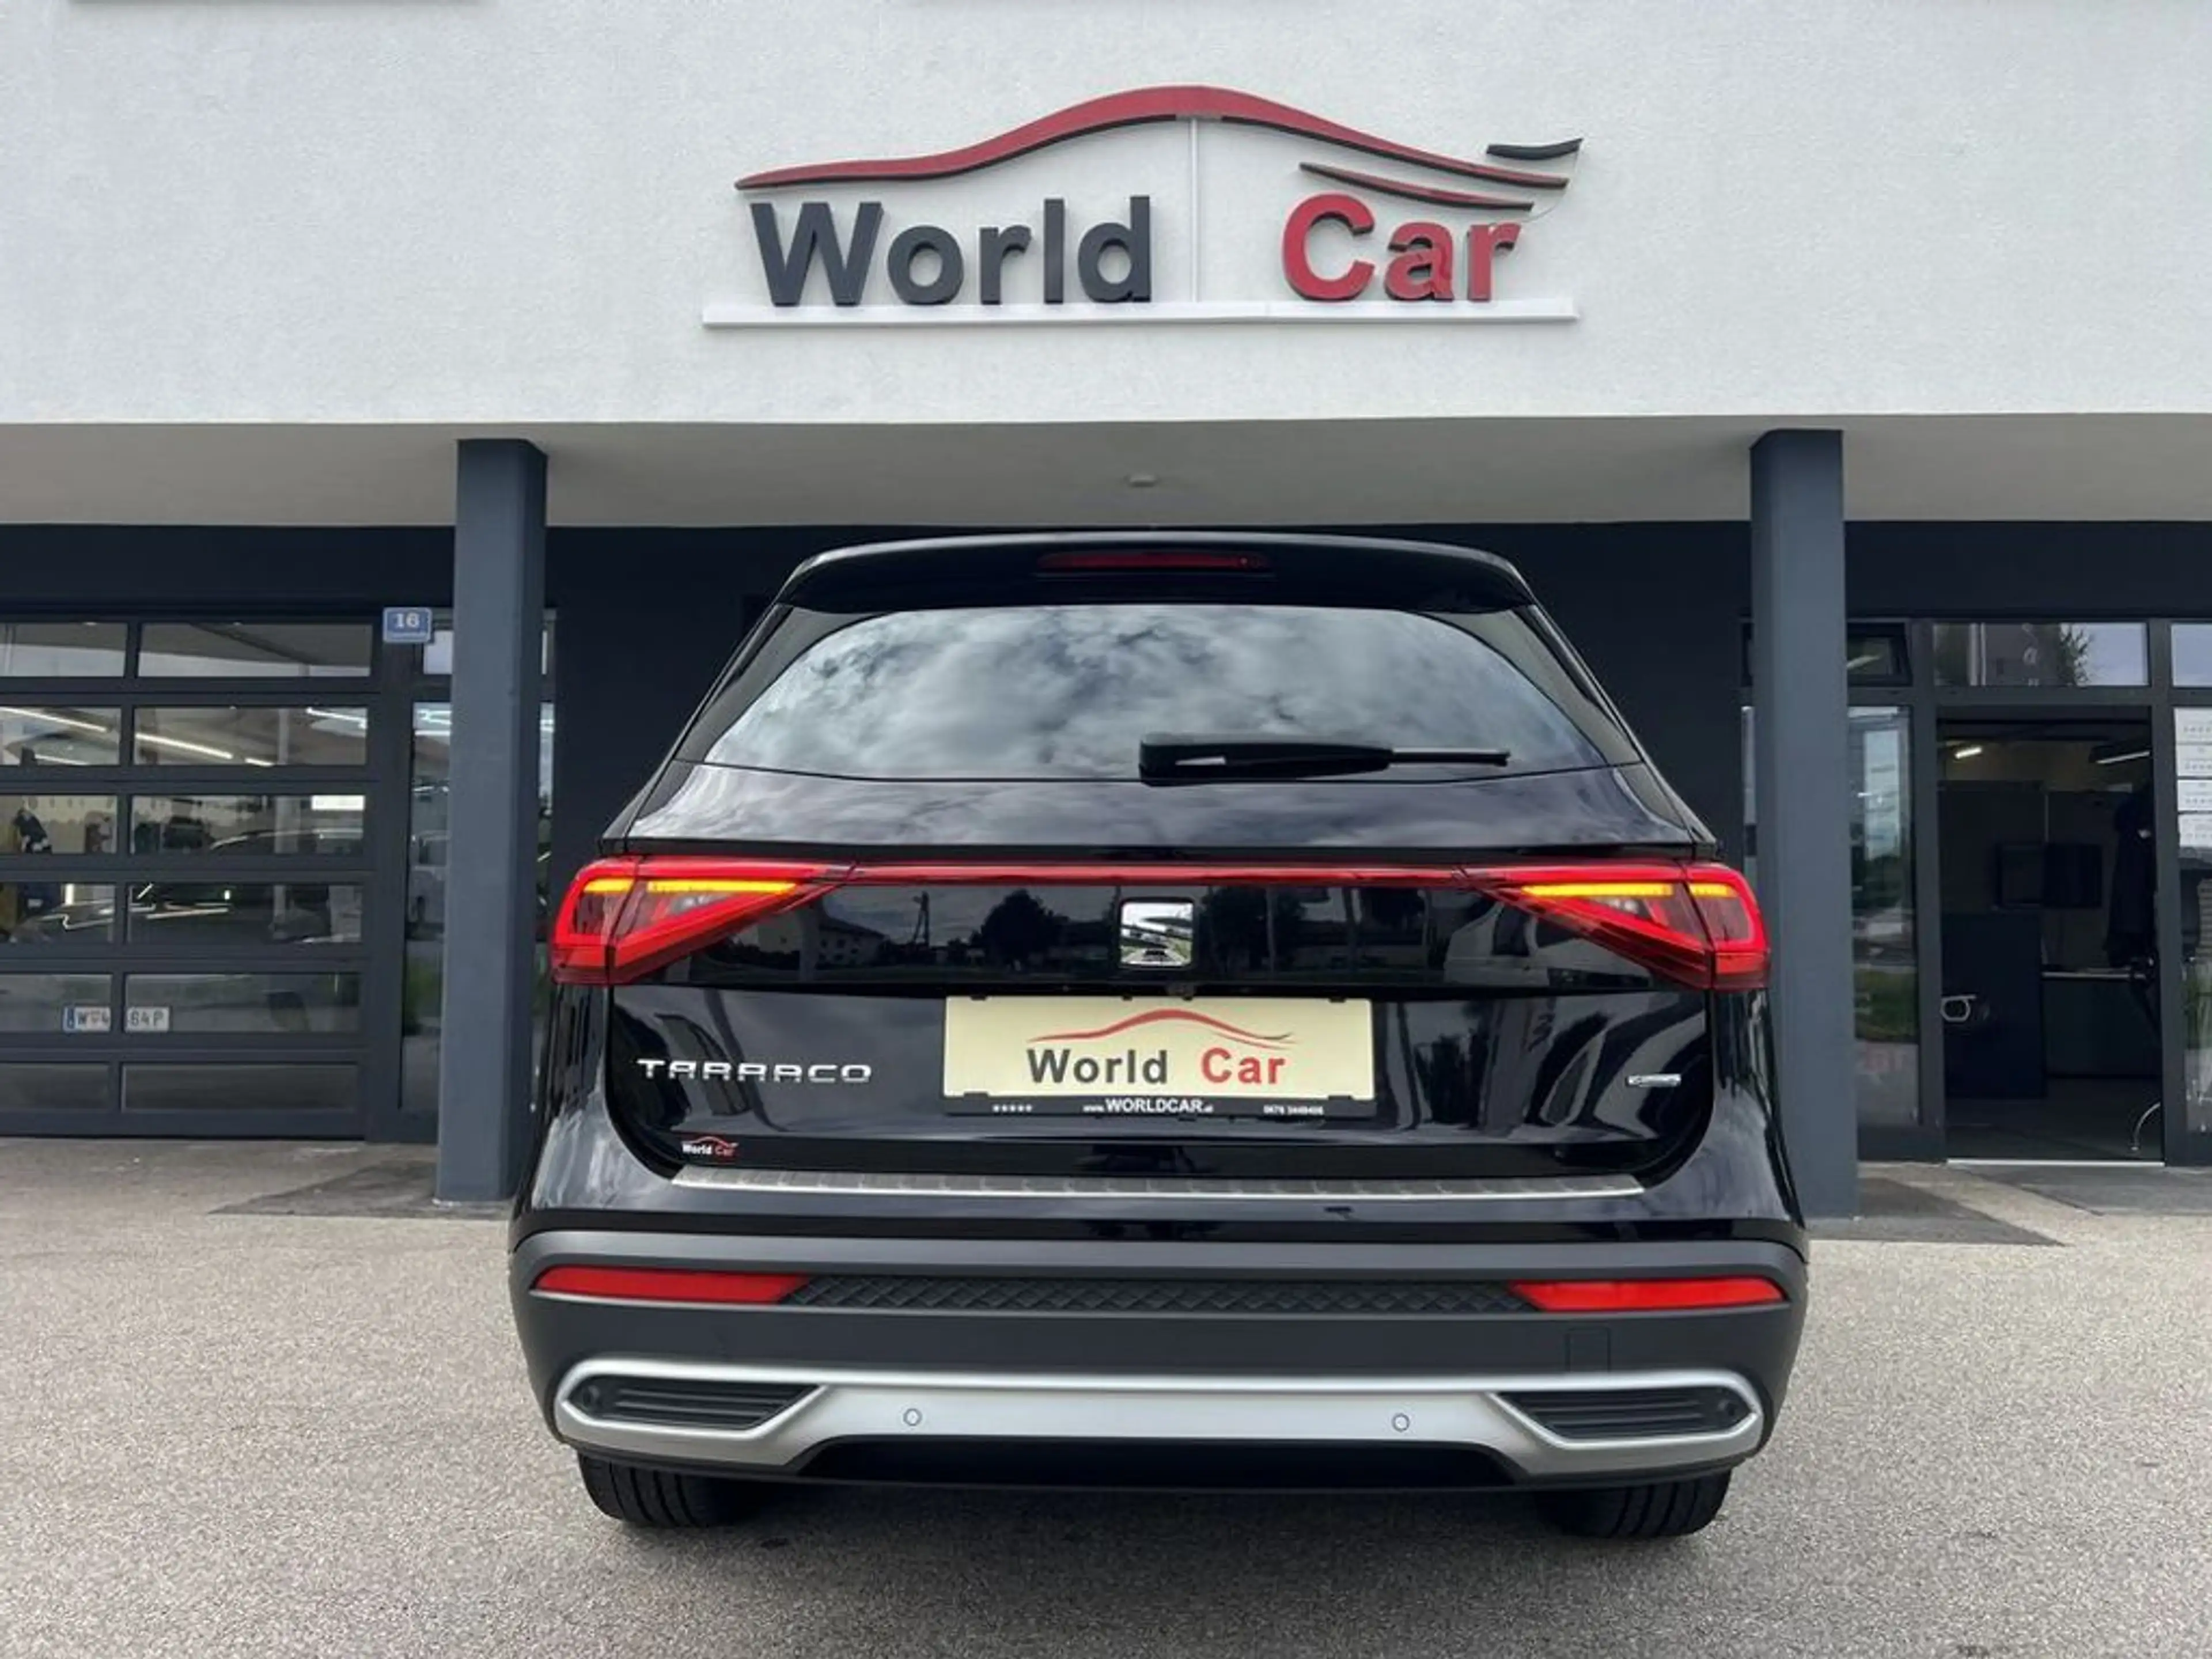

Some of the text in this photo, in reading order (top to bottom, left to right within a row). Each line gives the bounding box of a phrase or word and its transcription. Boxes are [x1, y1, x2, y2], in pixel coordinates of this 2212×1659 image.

[749, 192, 1521, 305] World Car
[395, 612, 421, 628] 16
[637, 1059, 872, 1083] TARRACO
[1027, 1047, 1285, 1084] World Car
[682, 1143, 712, 1155] World
